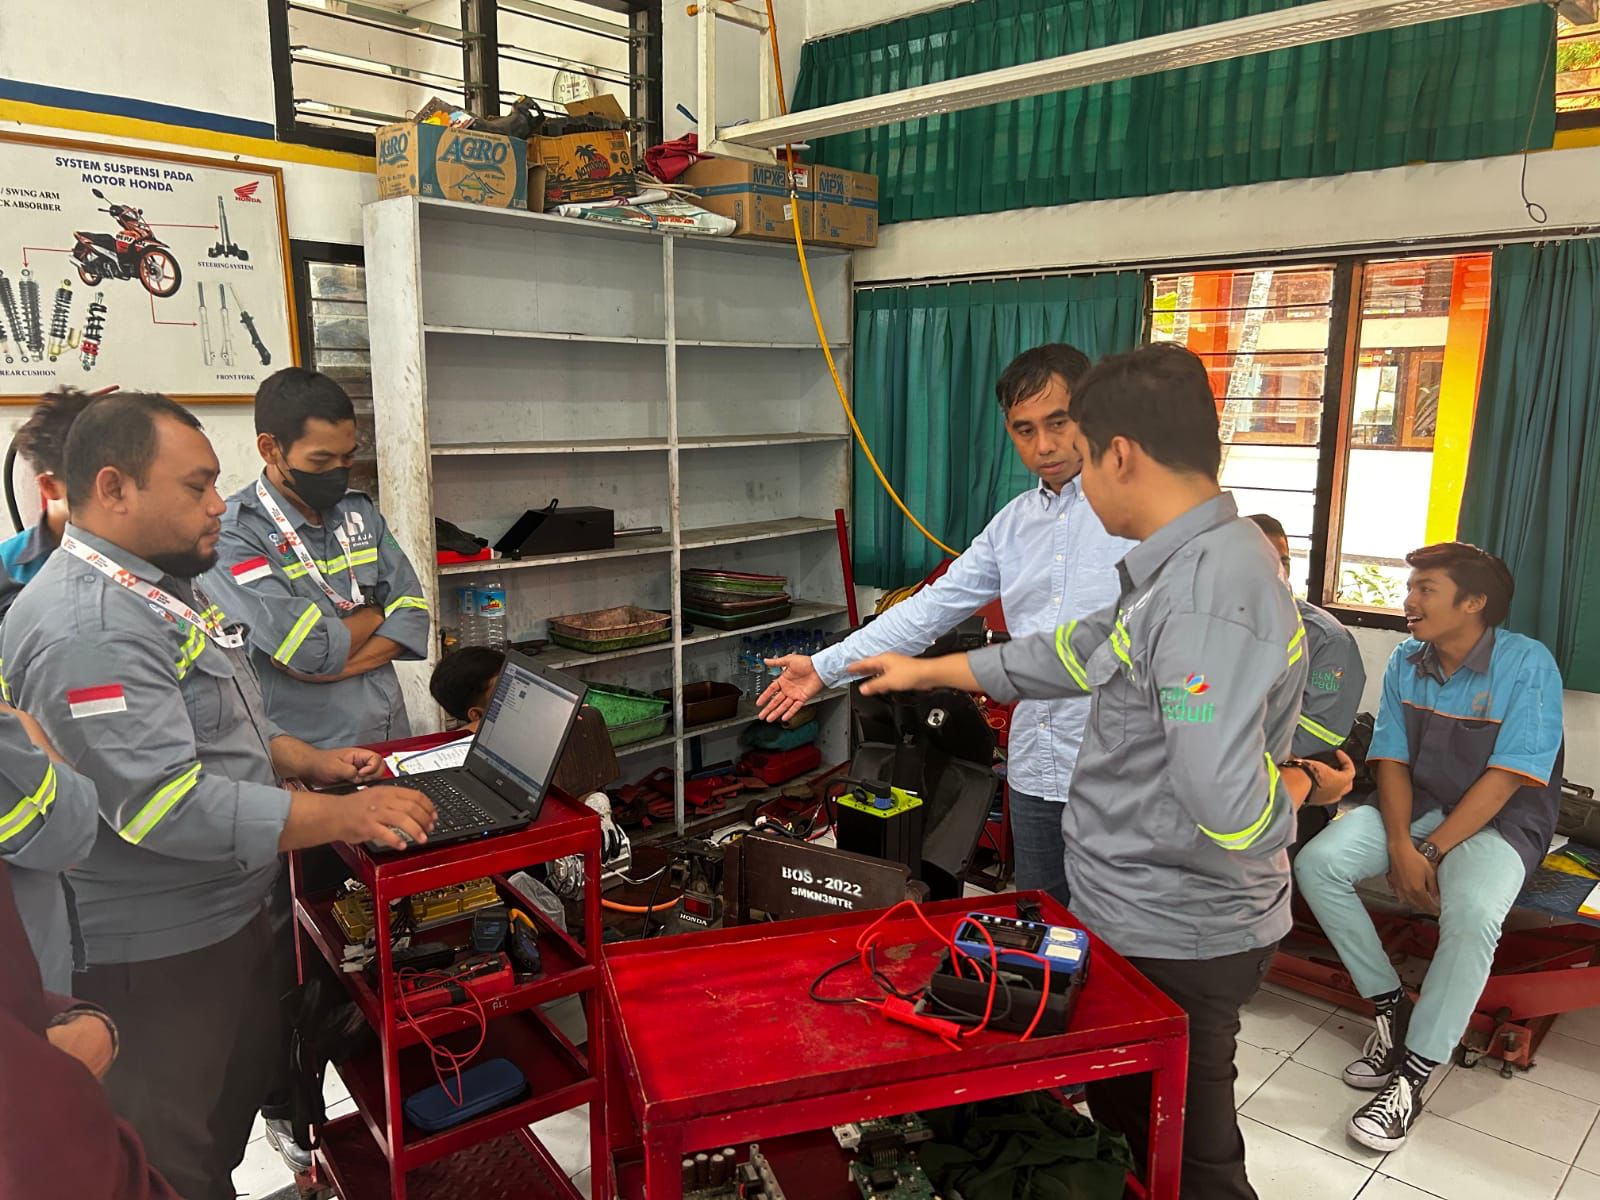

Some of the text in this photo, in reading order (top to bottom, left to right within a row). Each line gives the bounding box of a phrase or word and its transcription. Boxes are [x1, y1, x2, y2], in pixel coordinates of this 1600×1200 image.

[55, 157, 194, 182] SYSTEM SUSPENSI PADA
[82, 174, 173, 192] MOTOR HONDA
[6, 188, 37, 198] SWING
[39, 191, 60, 200] ARM
[235, 196, 262, 204] HONDA
[12, 201, 61, 211] ABSORBER
[782, 866, 814, 884] BOS
[824, 877, 863, 898] 2022
[791, 886, 853, 910] SMKN3MTR
[680, 913, 708, 926] HONDA
